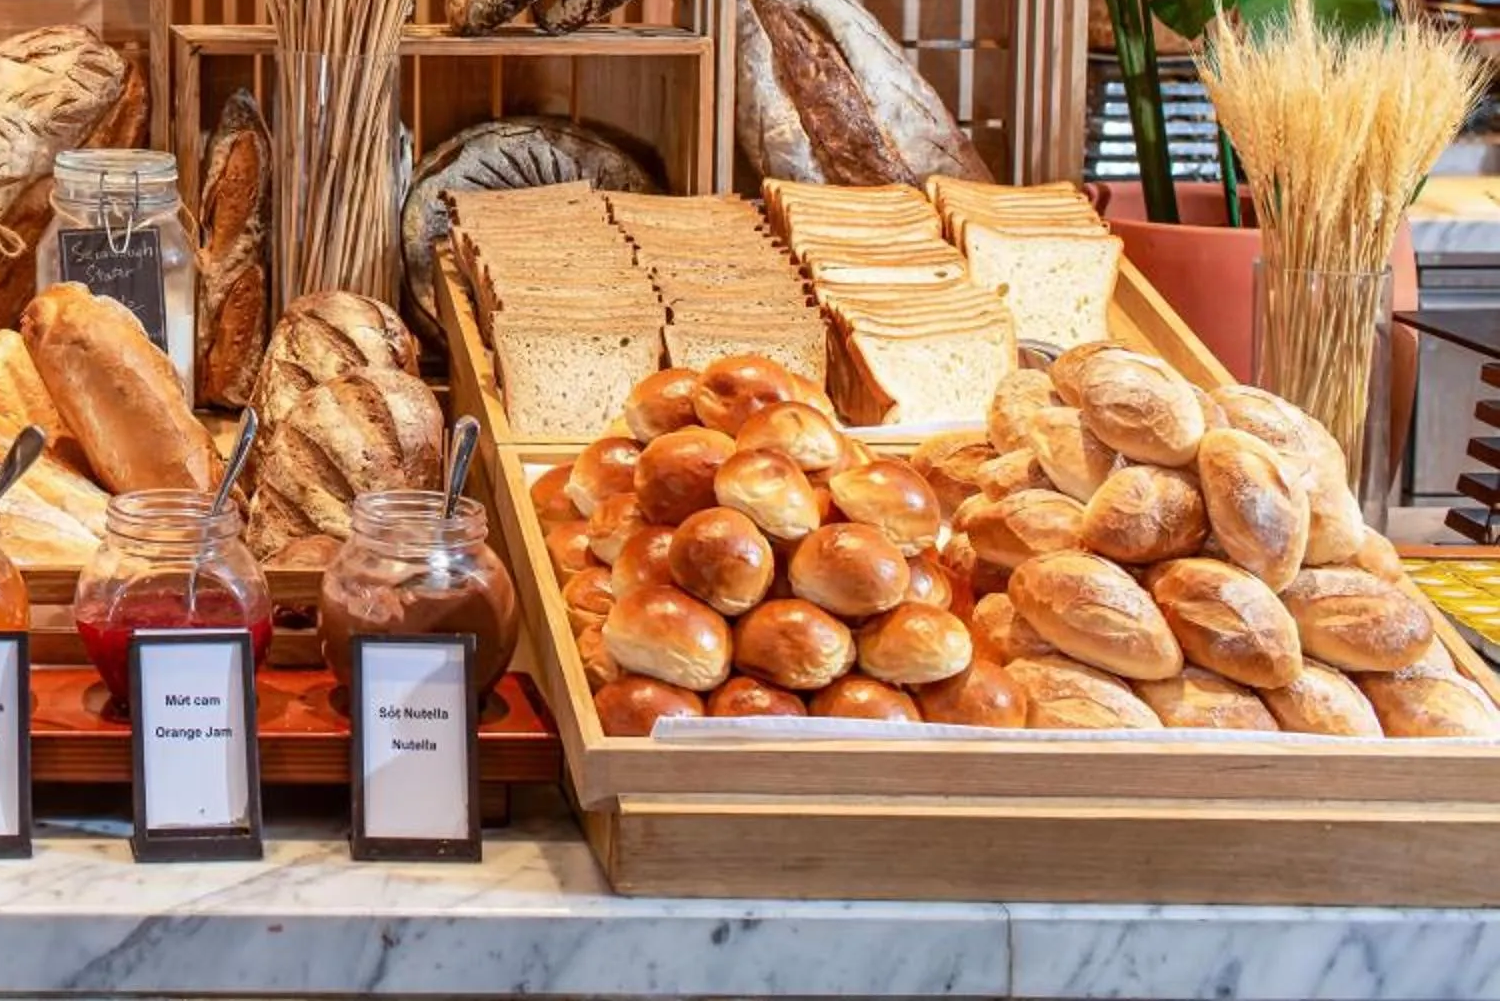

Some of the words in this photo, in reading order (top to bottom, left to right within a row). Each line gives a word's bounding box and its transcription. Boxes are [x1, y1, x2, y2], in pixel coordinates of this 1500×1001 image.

[193, 696, 221, 707] cam
[404, 707, 449, 720] Nutella
[155, 726, 202, 740] Orange
[205, 726, 233, 738] Jam
[391, 738, 437, 751] Nutella
